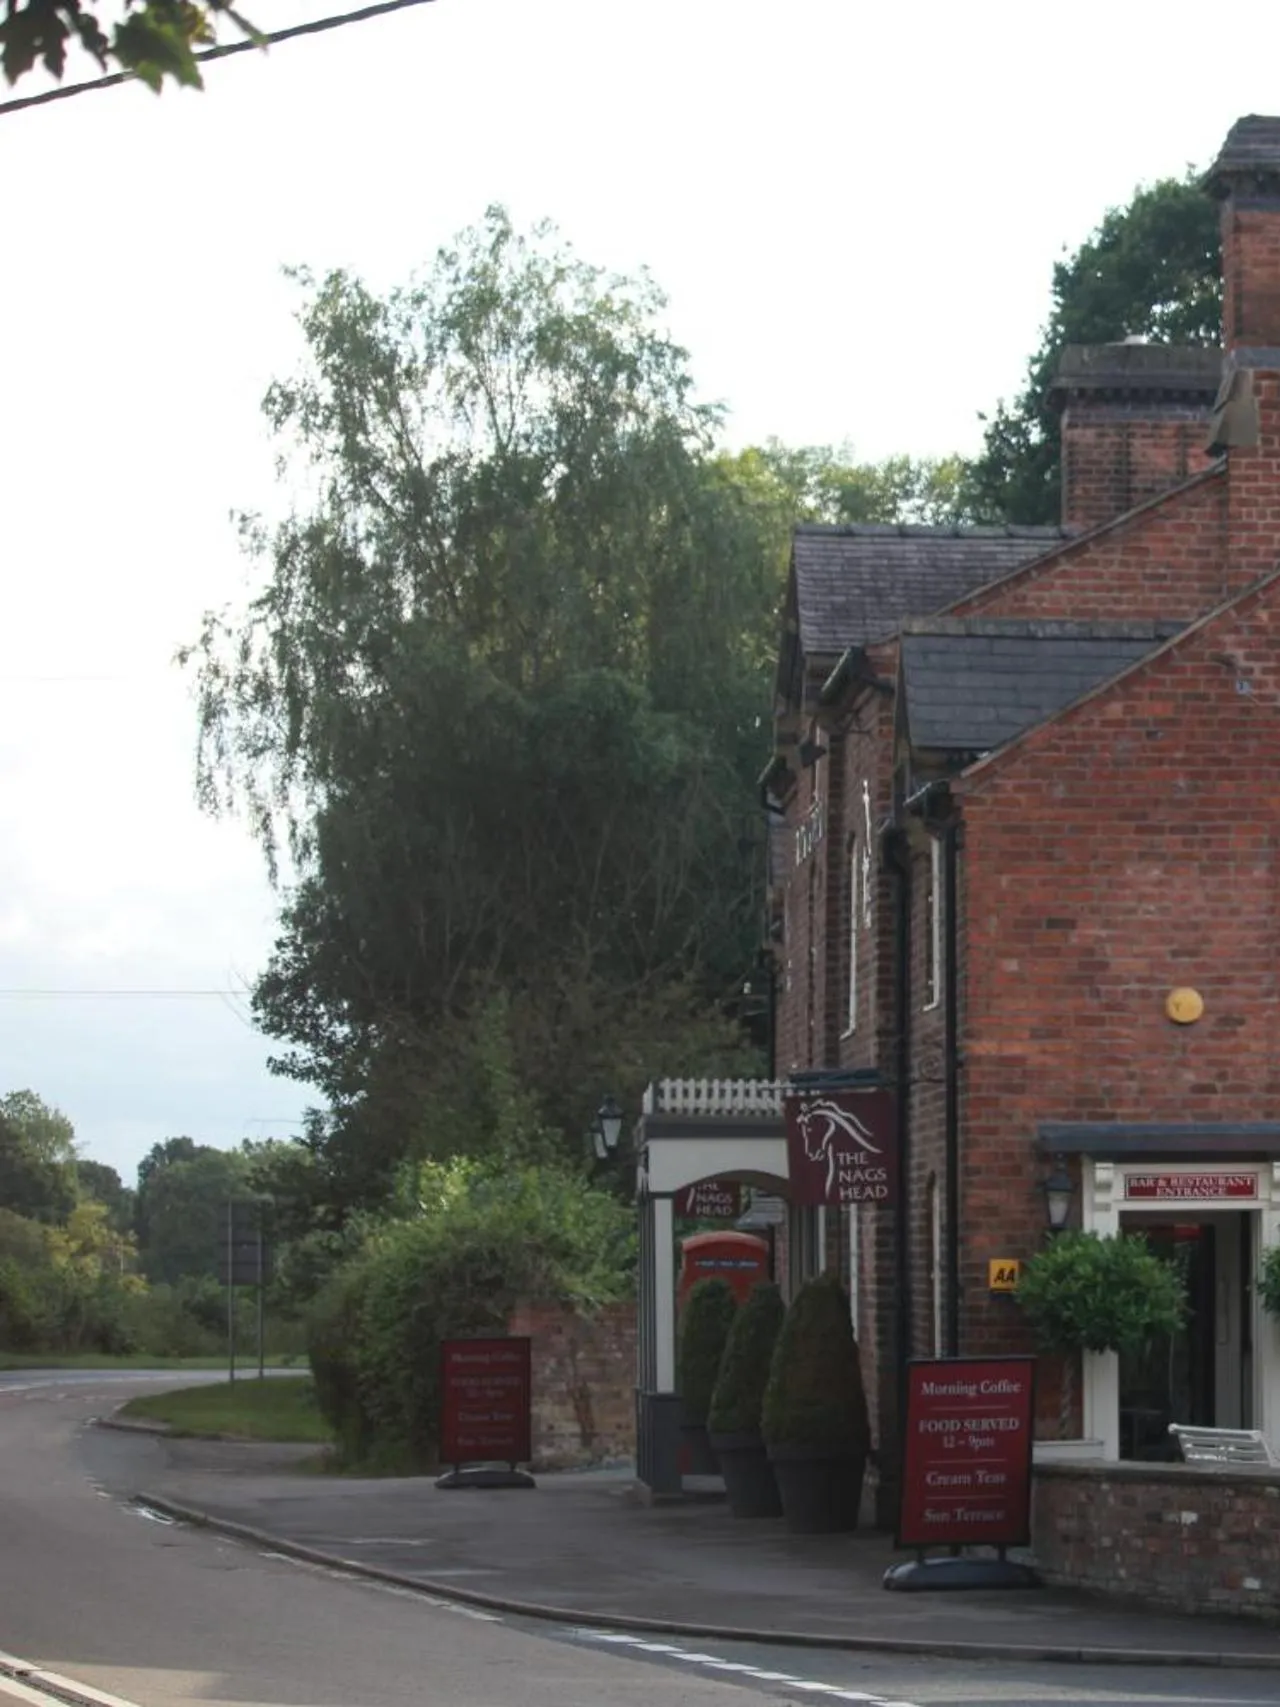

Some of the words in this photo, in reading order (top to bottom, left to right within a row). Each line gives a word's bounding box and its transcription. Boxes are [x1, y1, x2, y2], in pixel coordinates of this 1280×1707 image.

[836, 1151, 868, 1165] THE
[838, 1168, 888, 1183] NAGS
[1130, 1178, 1154, 1187] BAR
[1170, 1176, 1251, 1187] RESTAURANT
[839, 1186, 889, 1200] HEAD
[1156, 1186, 1226, 1197] ENTRANCE
[696, 1205, 732, 1216] HEAD
[994, 1268, 1015, 1283] AA
[921, 1382, 977, 1398] Morning
[980, 1379, 1021, 1394] Coffee
[919, 1419, 961, 1433] FOOD
[965, 1417, 1020, 1431] SERVED
[926, 1471, 971, 1486] Cream
